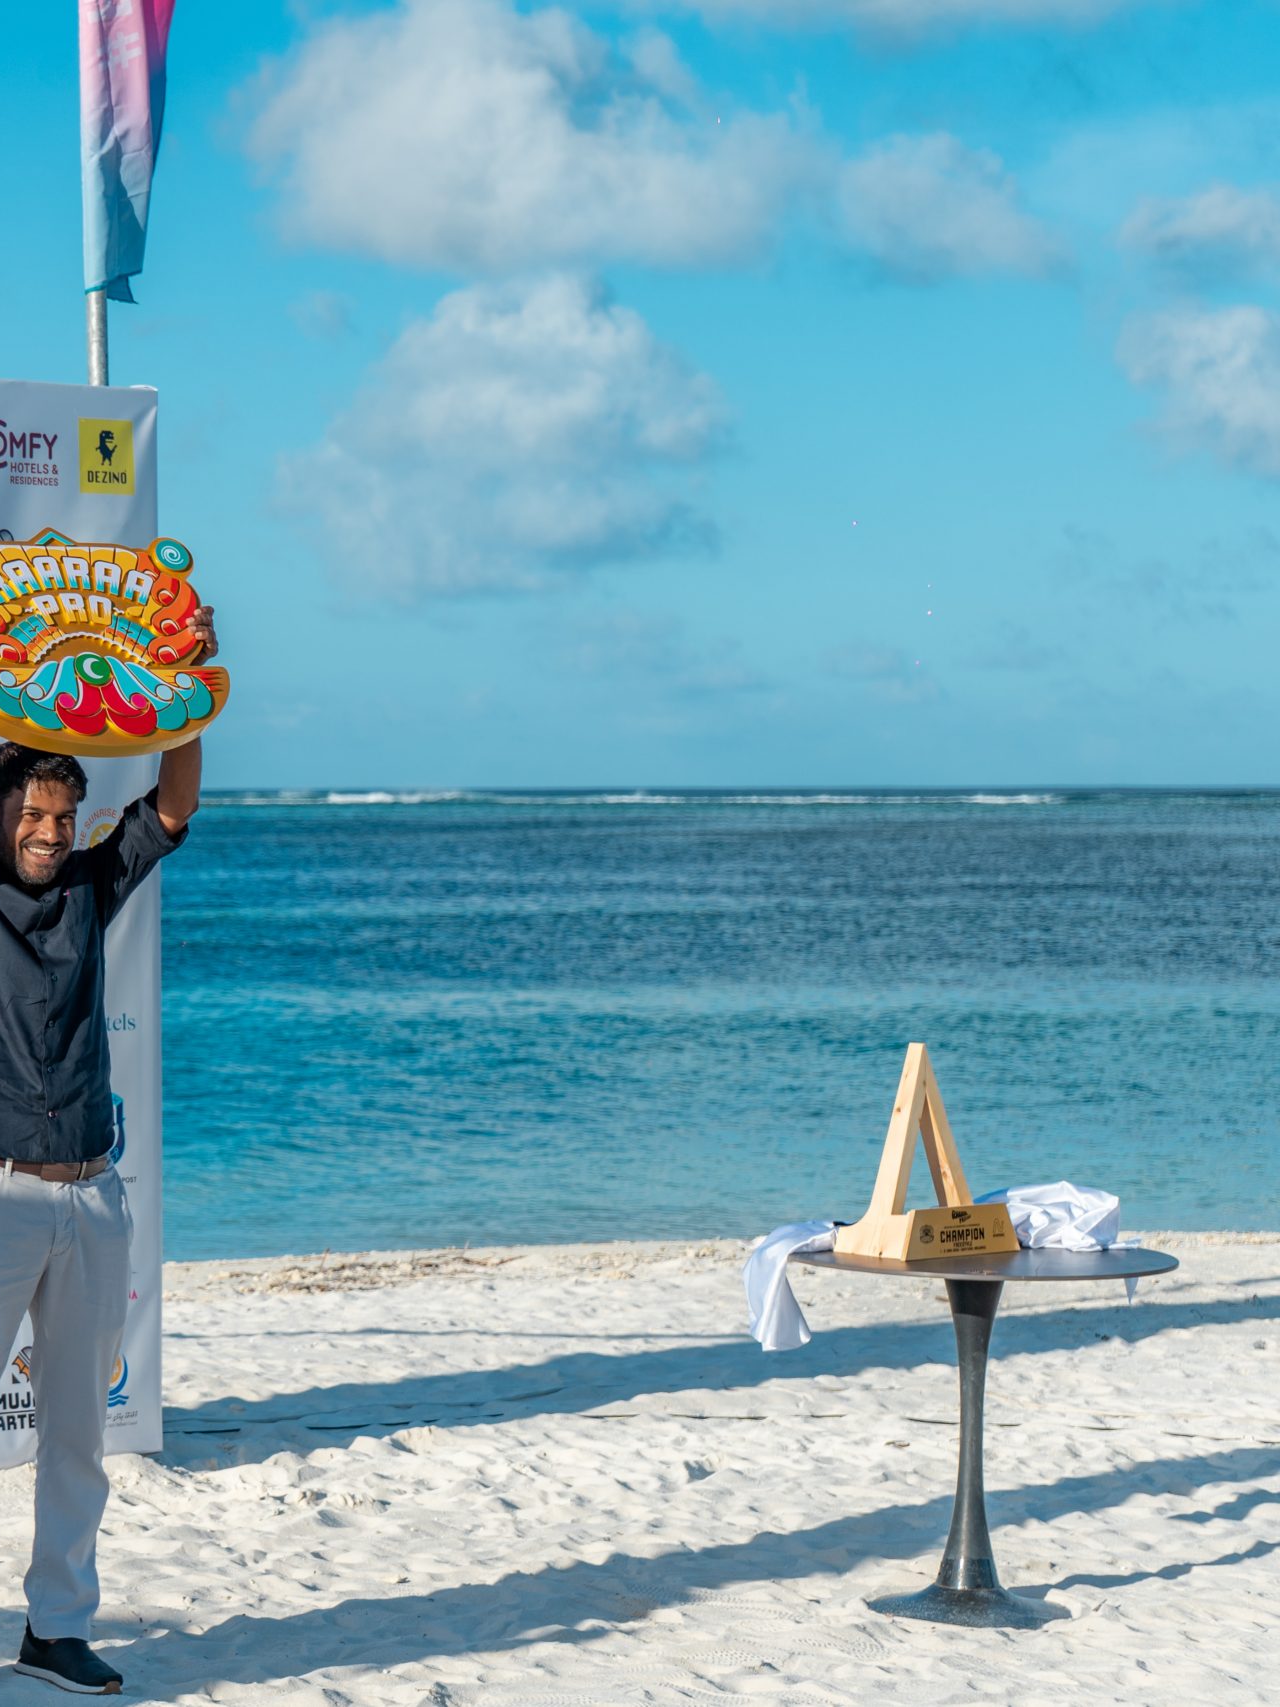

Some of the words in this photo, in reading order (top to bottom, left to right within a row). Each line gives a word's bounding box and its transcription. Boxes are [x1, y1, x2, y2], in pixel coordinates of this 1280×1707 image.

[10, 462, 49, 476] HOTELS
[52, 464, 58, 474] &
[10, 475, 58, 488] RESIDENCES
[87, 470, 128, 485] DEZINO
[32, 592, 113, 627] PRO
[84, 808, 118, 829] SUNRISE
[940, 1227, 984, 1243] CHAMPION
